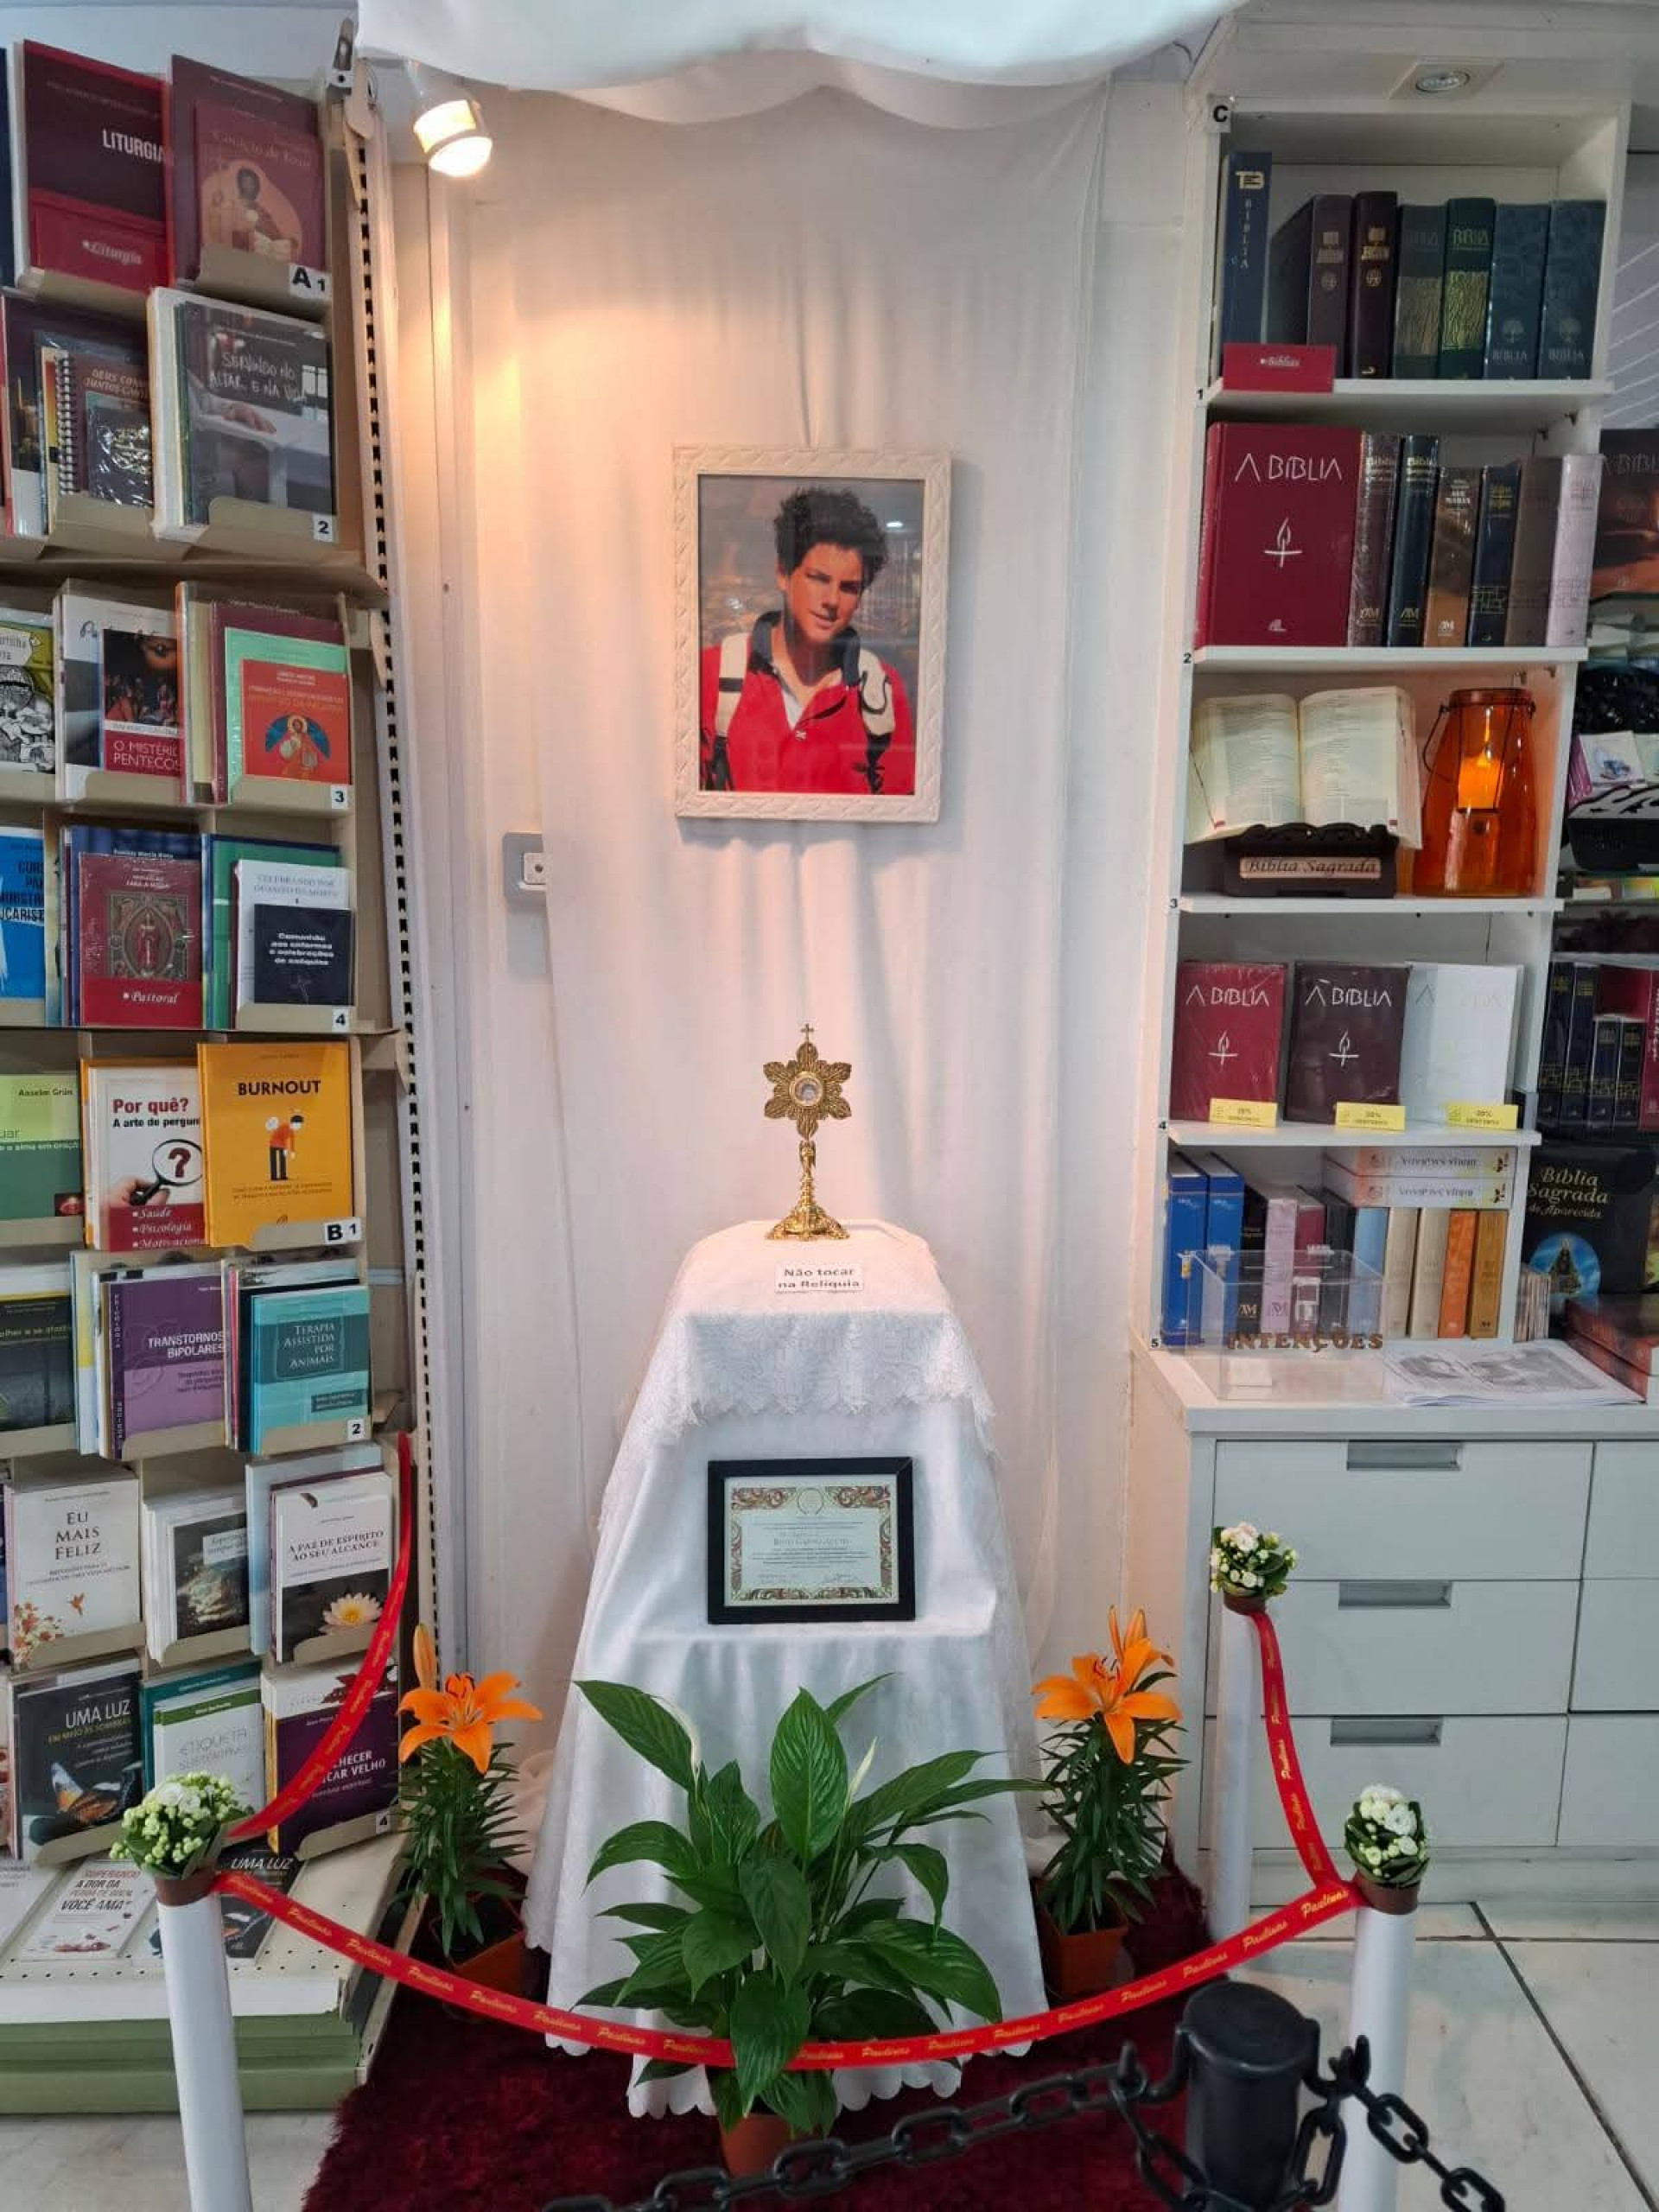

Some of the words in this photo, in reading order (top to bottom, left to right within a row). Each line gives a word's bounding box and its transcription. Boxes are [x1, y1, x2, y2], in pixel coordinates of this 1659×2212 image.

[1212, 105, 1229, 124] C
[317, 519, 330, 535] 2
[1183, 652, 1192, 664] 2
[334, 790, 346, 804] 3
[1169, 898, 1179, 909] 3
[130, 991, 179, 1006] Pastoral
[334, 1013, 346, 1026] 4
[238, 1080, 321, 1096] BURNOUT
[112, 1099, 143, 1114] Por
[147, 1097, 189, 1116] quê?
[112, 1118, 121, 1128] A
[123, 1118, 145, 1128] arte
[147, 1116, 160, 1127] de
[1527, 1183, 1608, 1205] Sagrada
[785, 1268, 814, 1277] Não
[817, 1268, 855, 1277] tocar
[148, 1330, 225, 1349] TRANSTORNOS
[1151, 1338, 1160, 1350] 5
[1227, 1331, 1383, 1353] INTENÇÕES
[167, 1343, 226, 1359] BIPOLARES
[351, 1422, 362, 1436] 2
[67, 1511, 88, 1526] EU
[55, 1526, 100, 1544] MAIS
[319, 1537, 334, 1548] DE
[55, 1541, 100, 1560] FELIZ
[66, 1707, 102, 1729] UMA
[105, 1699, 131, 1719] LUZ
[334, 1750, 373, 1769] HECER
[351, 1758, 387, 1777] VELHO
[231, 1857, 264, 1870] UMA
[266, 1857, 294, 1870] LUZ
[1300, 1886, 1351, 1919] Paulinas
[1242, 1918, 1289, 1952] Paulinas
